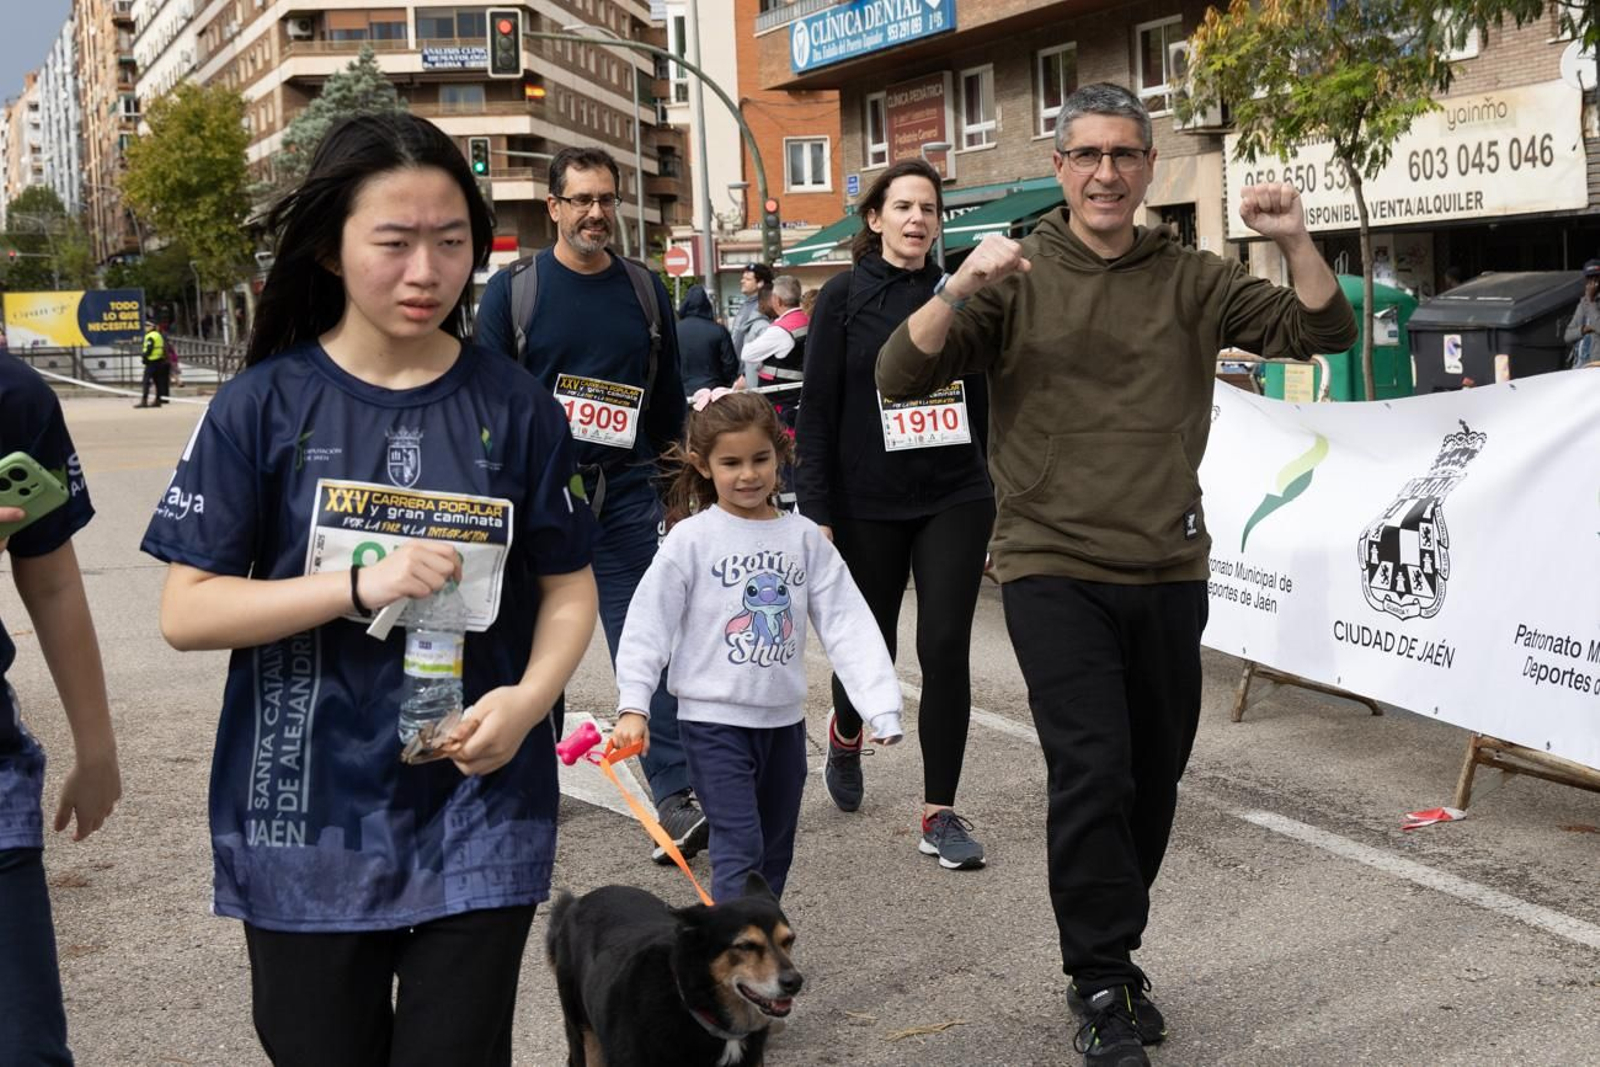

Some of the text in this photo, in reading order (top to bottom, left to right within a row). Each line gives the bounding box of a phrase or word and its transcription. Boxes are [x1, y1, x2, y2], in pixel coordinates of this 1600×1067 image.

[811, 9, 863, 46] CLÍNICA
[865, 0, 922, 30] DENTAL
[1408, 133, 1553, 182] 603 045 046
[1324, 161, 1348, 191] 53
[1305, 191, 1483, 225] ISPONIBL VENTA/ALQUILER
[103, 311, 139, 320] LO QUE
[110, 302, 139, 310] TODO
[88, 322, 139, 331] NECESITAS
[564, 400, 628, 432] 1909
[893, 408, 958, 434] 1910
[325, 488, 503, 518] XXV CARRERA POPULAR
[387, 508, 424, 520] gran
[433, 511, 503, 528] caminata
[1208, 558, 1292, 593] ronato Municipal de
[1207, 581, 1277, 614] eportes de Jaén
[1333, 620, 1456, 669] CIUDAD DE JAÉN
[1514, 623, 1582, 658] Patronato
[1522, 655, 1592, 693] Deportes
[277, 629, 312, 812] DE ALEJANDRI
[254, 733, 275, 810] SANTA
[245, 812, 306, 848] JAÉN
